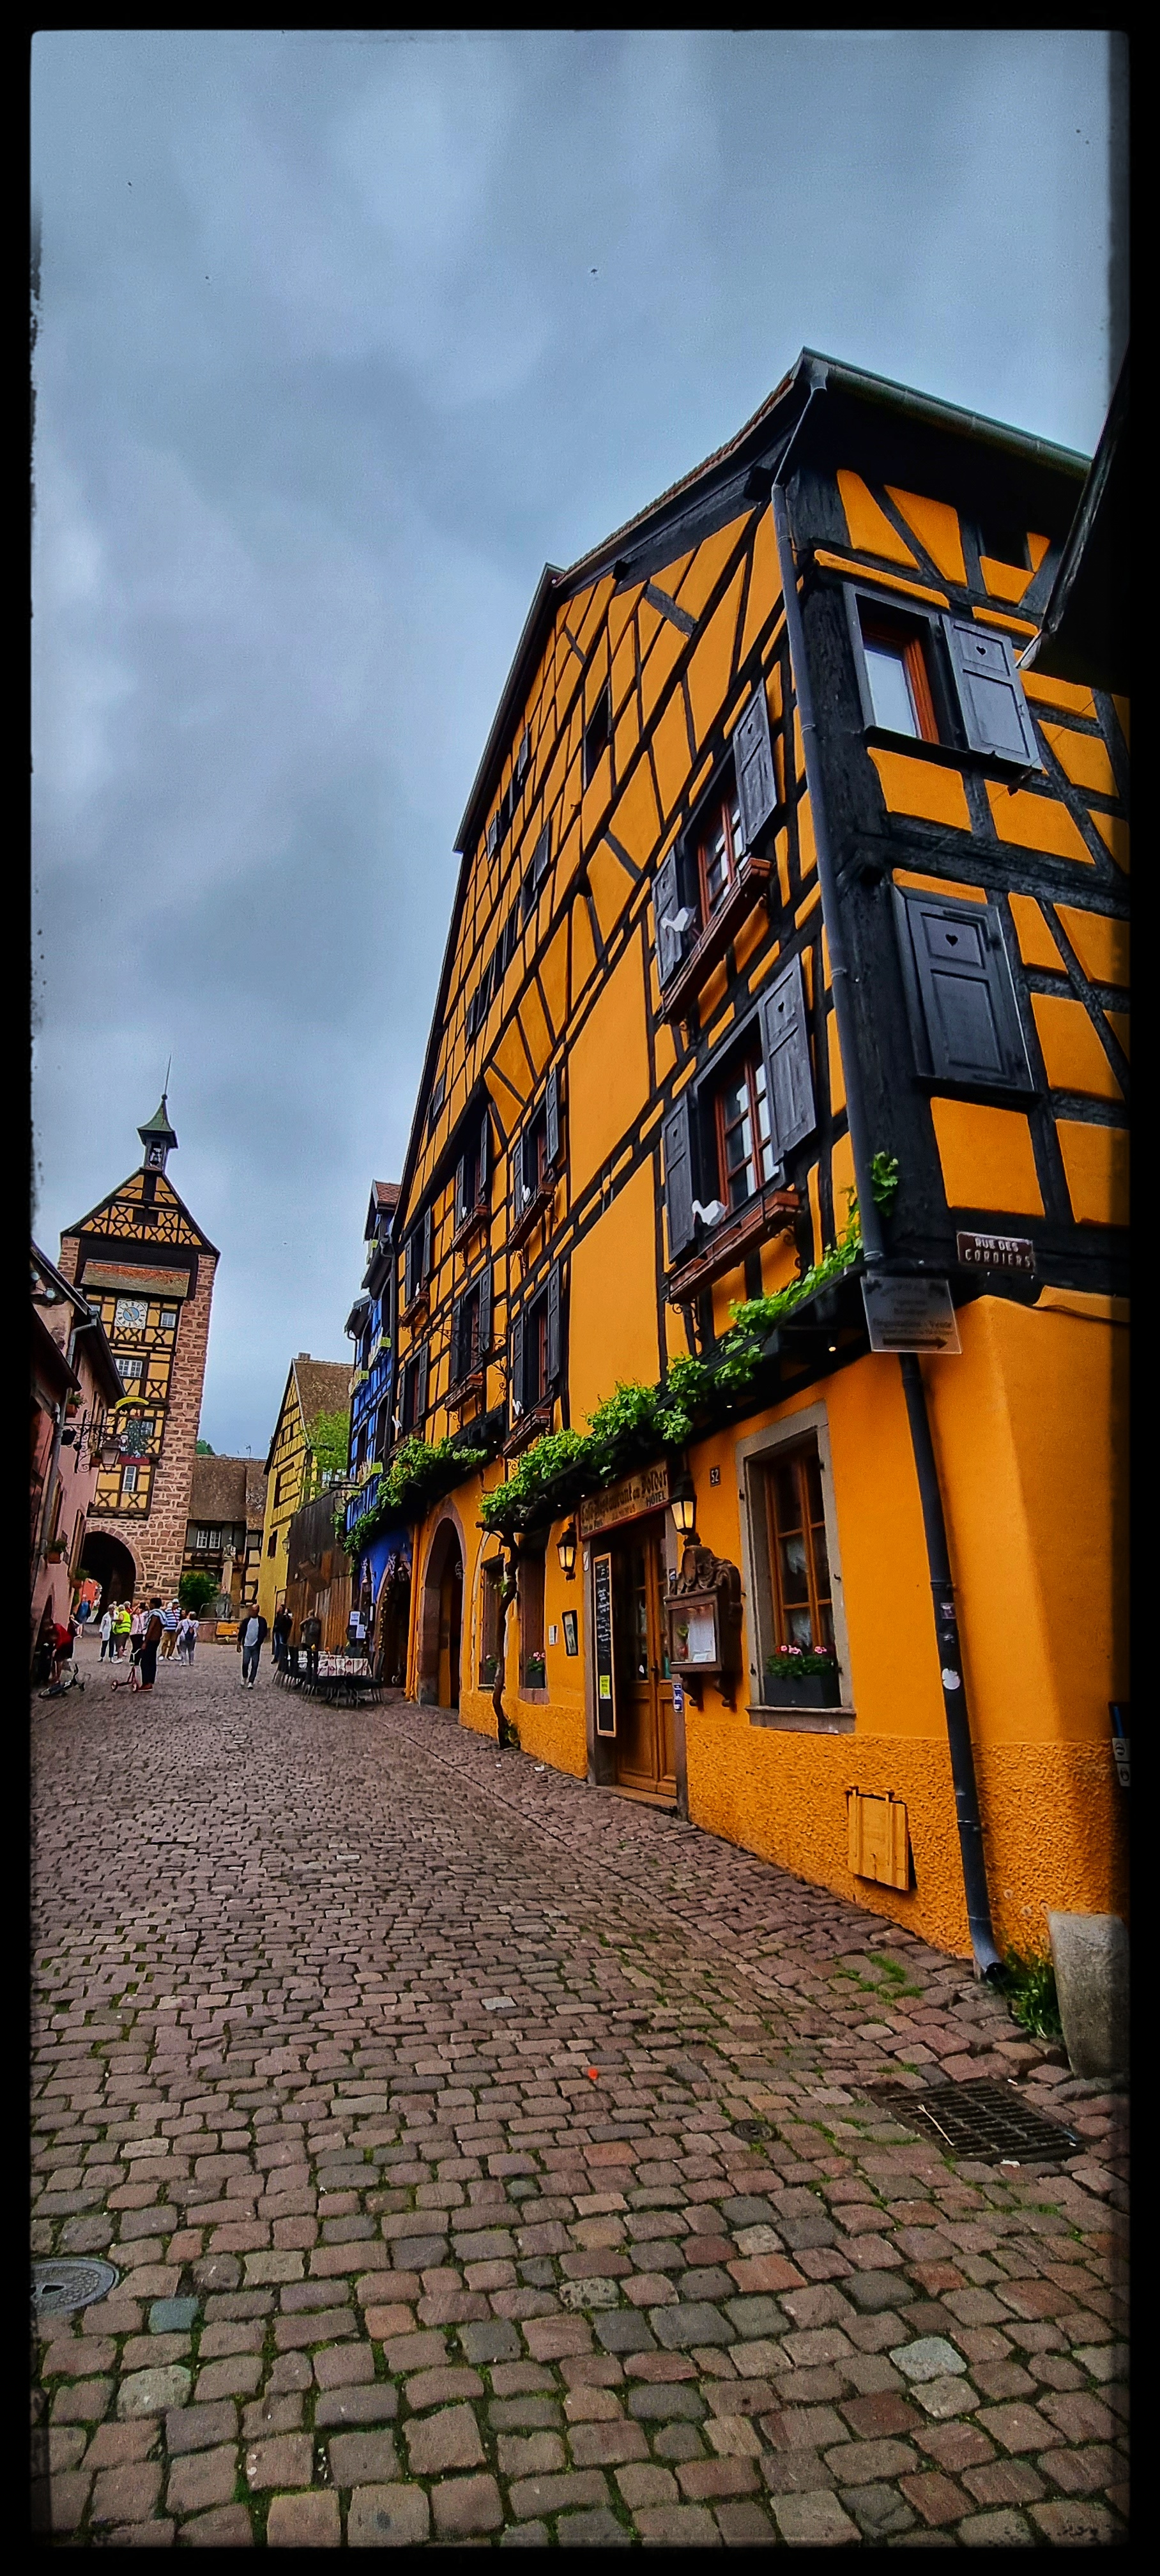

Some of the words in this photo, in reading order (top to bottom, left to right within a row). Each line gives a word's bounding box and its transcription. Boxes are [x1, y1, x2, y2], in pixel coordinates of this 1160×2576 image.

[975, 1237, 995, 1249] RUE
[998, 1239, 1019, 1252] DES
[965, 1248, 1030, 1268] CORDIERS
[711, 1468, 719, 1483] 52
